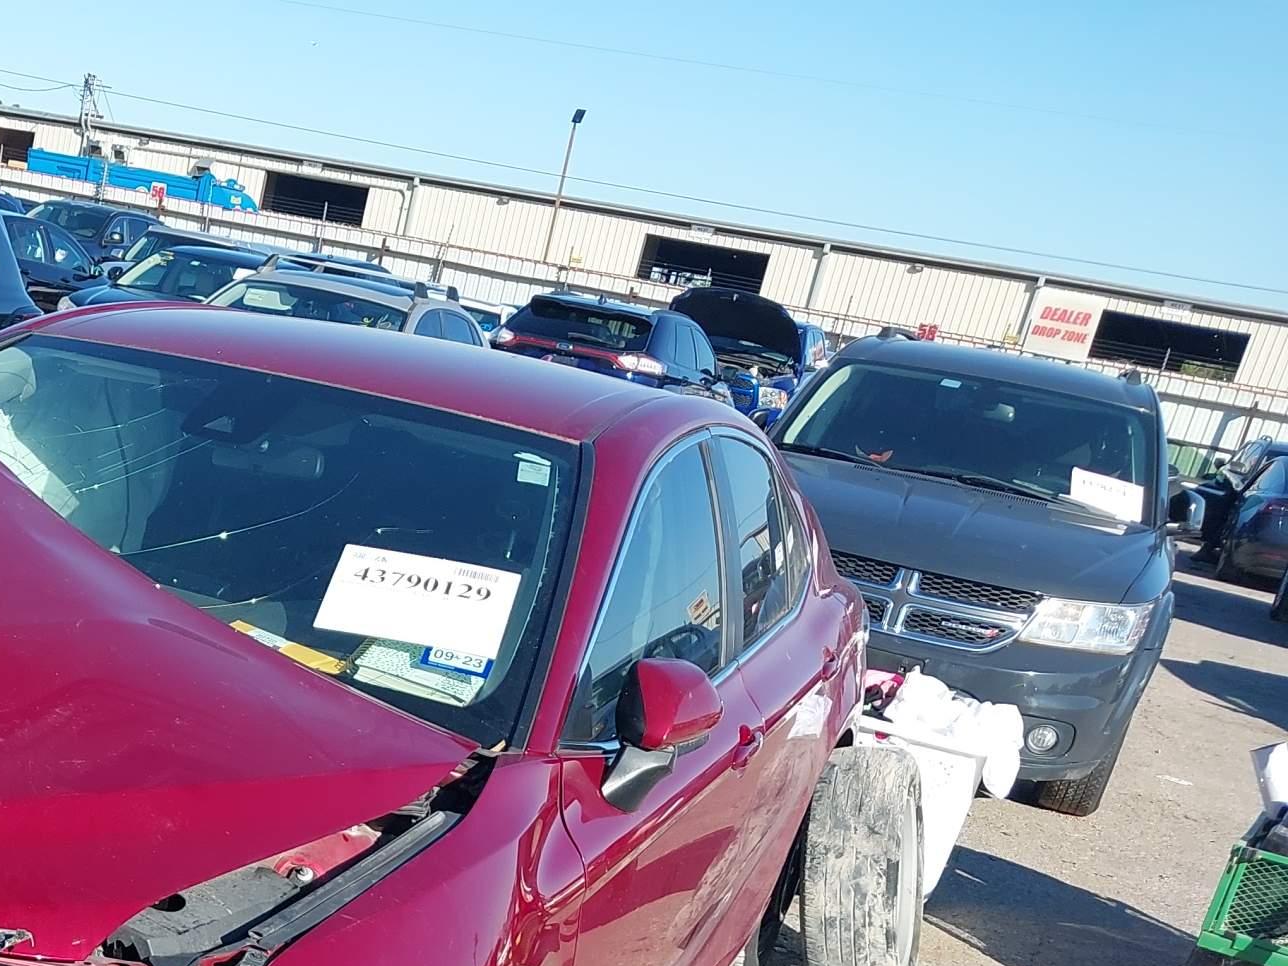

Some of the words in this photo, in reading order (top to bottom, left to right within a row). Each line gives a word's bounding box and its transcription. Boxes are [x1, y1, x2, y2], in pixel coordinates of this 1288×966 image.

[1039, 306, 1092, 327] DEALER
[1031, 325, 1062, 339] DROP
[1061, 330, 1089, 344] ZONE
[353, 566, 492, 602] 43790129
